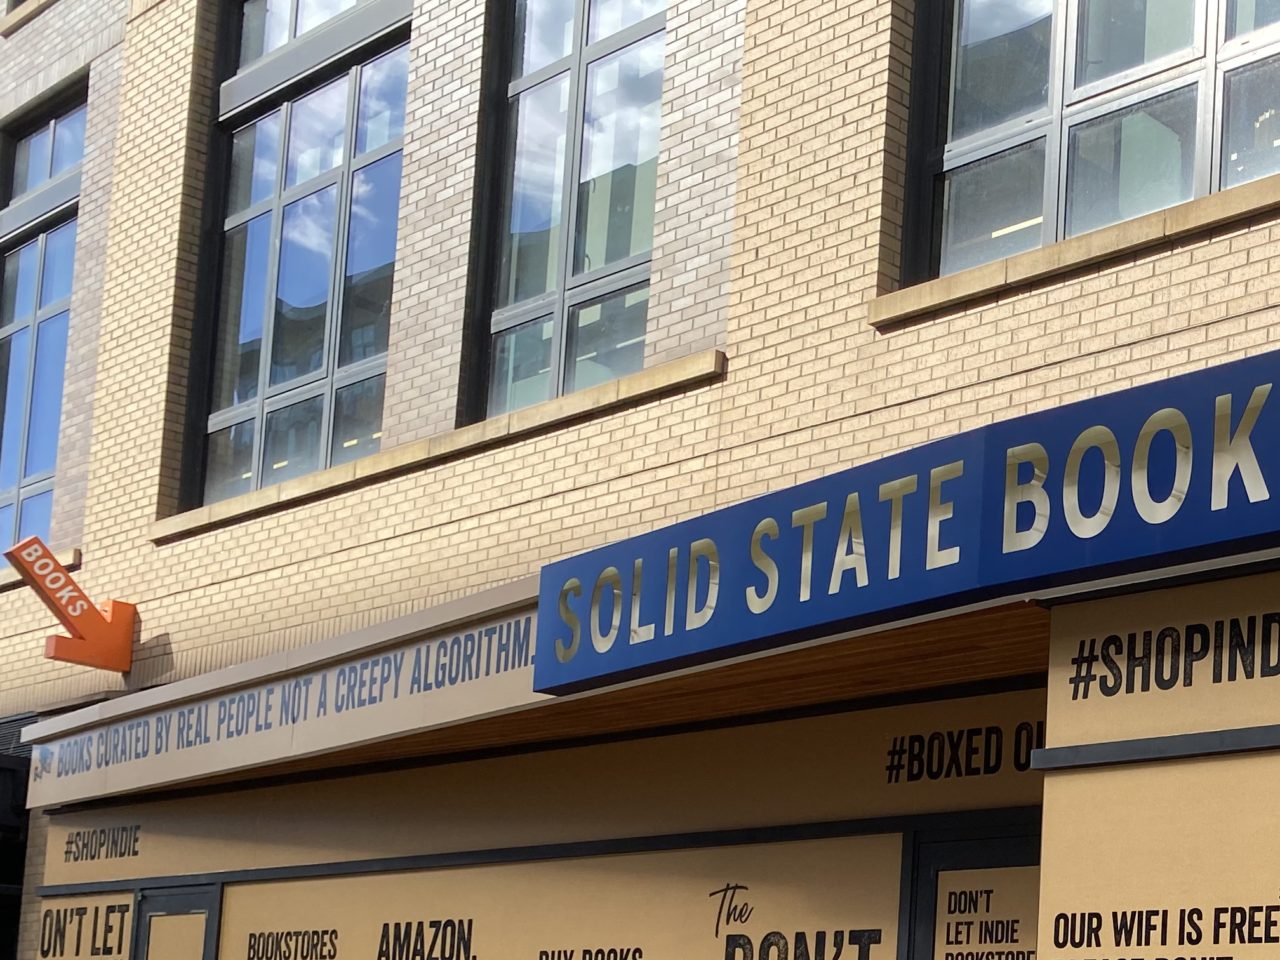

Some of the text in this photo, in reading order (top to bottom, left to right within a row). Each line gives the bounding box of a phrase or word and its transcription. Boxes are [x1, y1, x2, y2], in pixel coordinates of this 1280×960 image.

[19, 542, 89, 617] BOOKS
[554, 536, 720, 666] SOLID
[743, 457, 965, 617] STATE
[56, 617, 535, 778] BOOKS CURATED BY REAL PEOPLE NOT A CREEPY ALGORITHM.
[886, 725, 1002, 784] #BOXED
[64, 824, 140, 863] #SHOPINDIE
[90, 904, 129, 956] LET
[1053, 911, 1102, 949] OUR
[1111, 909, 1168, 947] WIFI
[1178, 907, 1202, 946] IS
